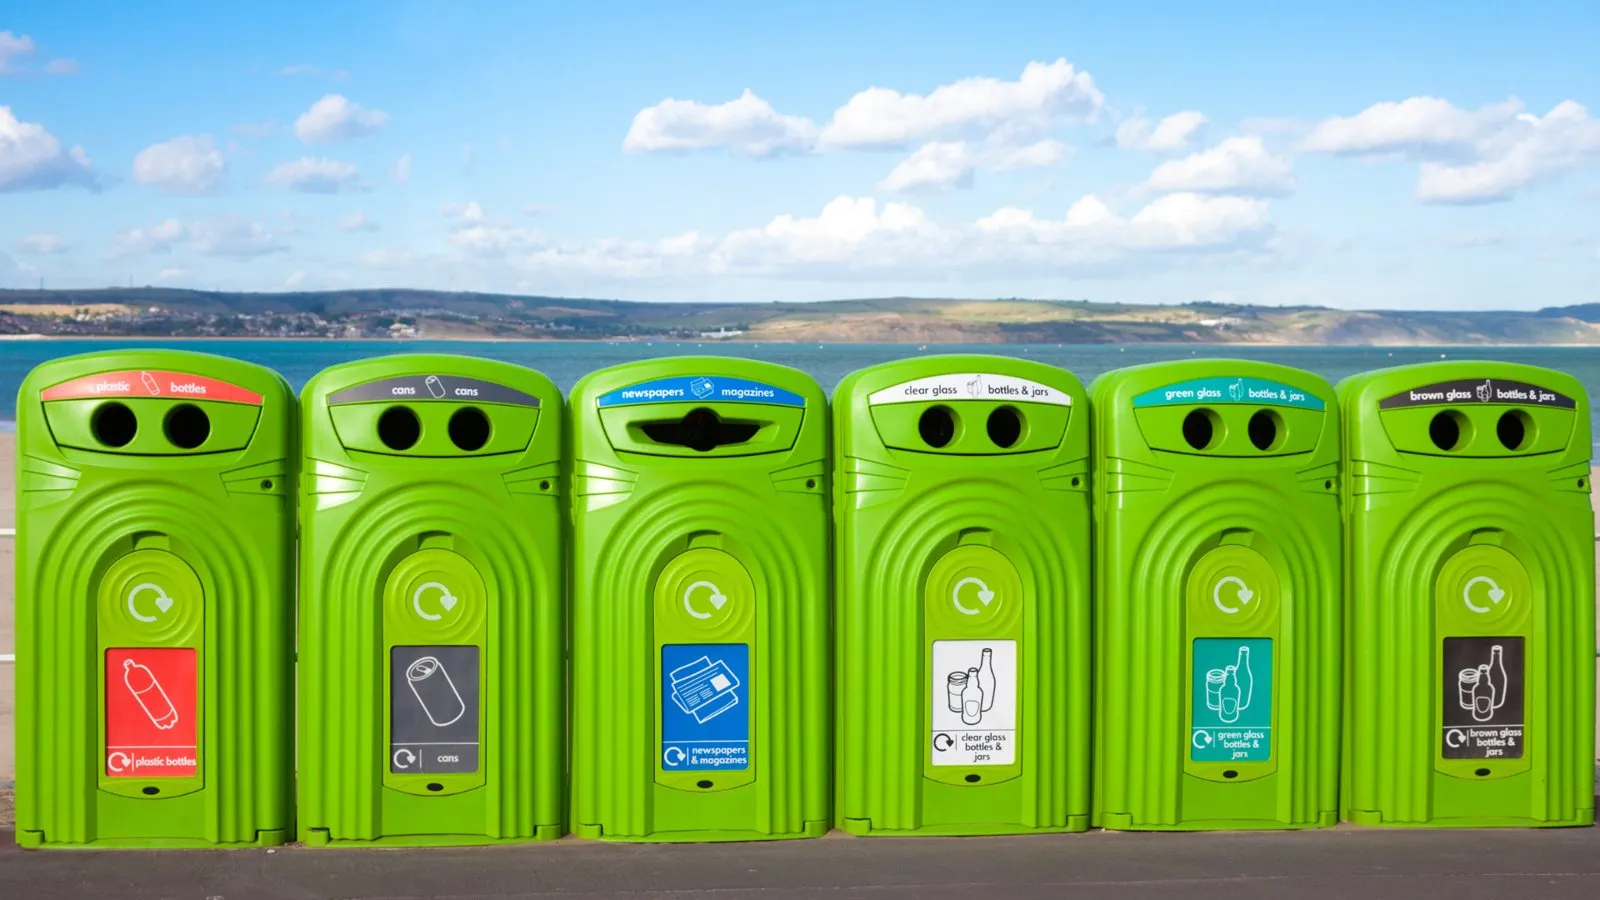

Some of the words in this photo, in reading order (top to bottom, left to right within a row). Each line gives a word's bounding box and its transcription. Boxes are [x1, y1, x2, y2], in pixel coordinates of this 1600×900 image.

[96, 380, 130, 393] plastic
[170, 381, 207, 394] bottles
[392, 386, 416, 396] cans
[455, 386, 478, 396] cans
[904, 384, 928, 395] clear
[932, 384, 958, 397] glass
[988, 384, 1020, 395] bottles
[1022, 386, 1029, 396] &
[1031, 386, 1049, 397] jars
[621, 387, 685, 399] newspapers
[722, 386, 774, 398] magazines
[1165, 389, 1194, 400] green
[1196, 388, 1222, 400] glass
[1248, 388, 1278, 399] bottles
[1280, 390, 1286, 399] &
[1288, 390, 1305, 401] jars
[1410, 390, 1445, 401] brown
[1446, 390, 1472, 402] glass
[1496, 389, 1528, 400] bottles
[1529, 390, 1537, 400] &
[1538, 390, 1556, 402] jars
[962, 732, 983, 742] clear
[984, 732, 1006, 744] glass
[1218, 732, 1242, 742] green
[1244, 730, 1264, 741] glass
[1470, 728, 1498, 738] brown
[1500, 728, 1522, 739] glass
[965, 742, 993, 751] bottles
[996, 742, 1002, 751] &
[1224, 740, 1251, 748] bottles
[1252, 740, 1260, 748] &
[1476, 738, 1506, 746] bottles
[1508, 738, 1516, 746] &
[692, 746, 746, 756] newspapers
[1232, 750, 1248, 760] jars
[1485, 748, 1504, 757] jars
[136, 756, 164, 768] plastic
[166, 756, 197, 766] bottles
[437, 755, 459, 763] cans
[691, 756, 698, 764] &
[700, 756, 747, 766] magazines
[973, 753, 991, 762] jars
